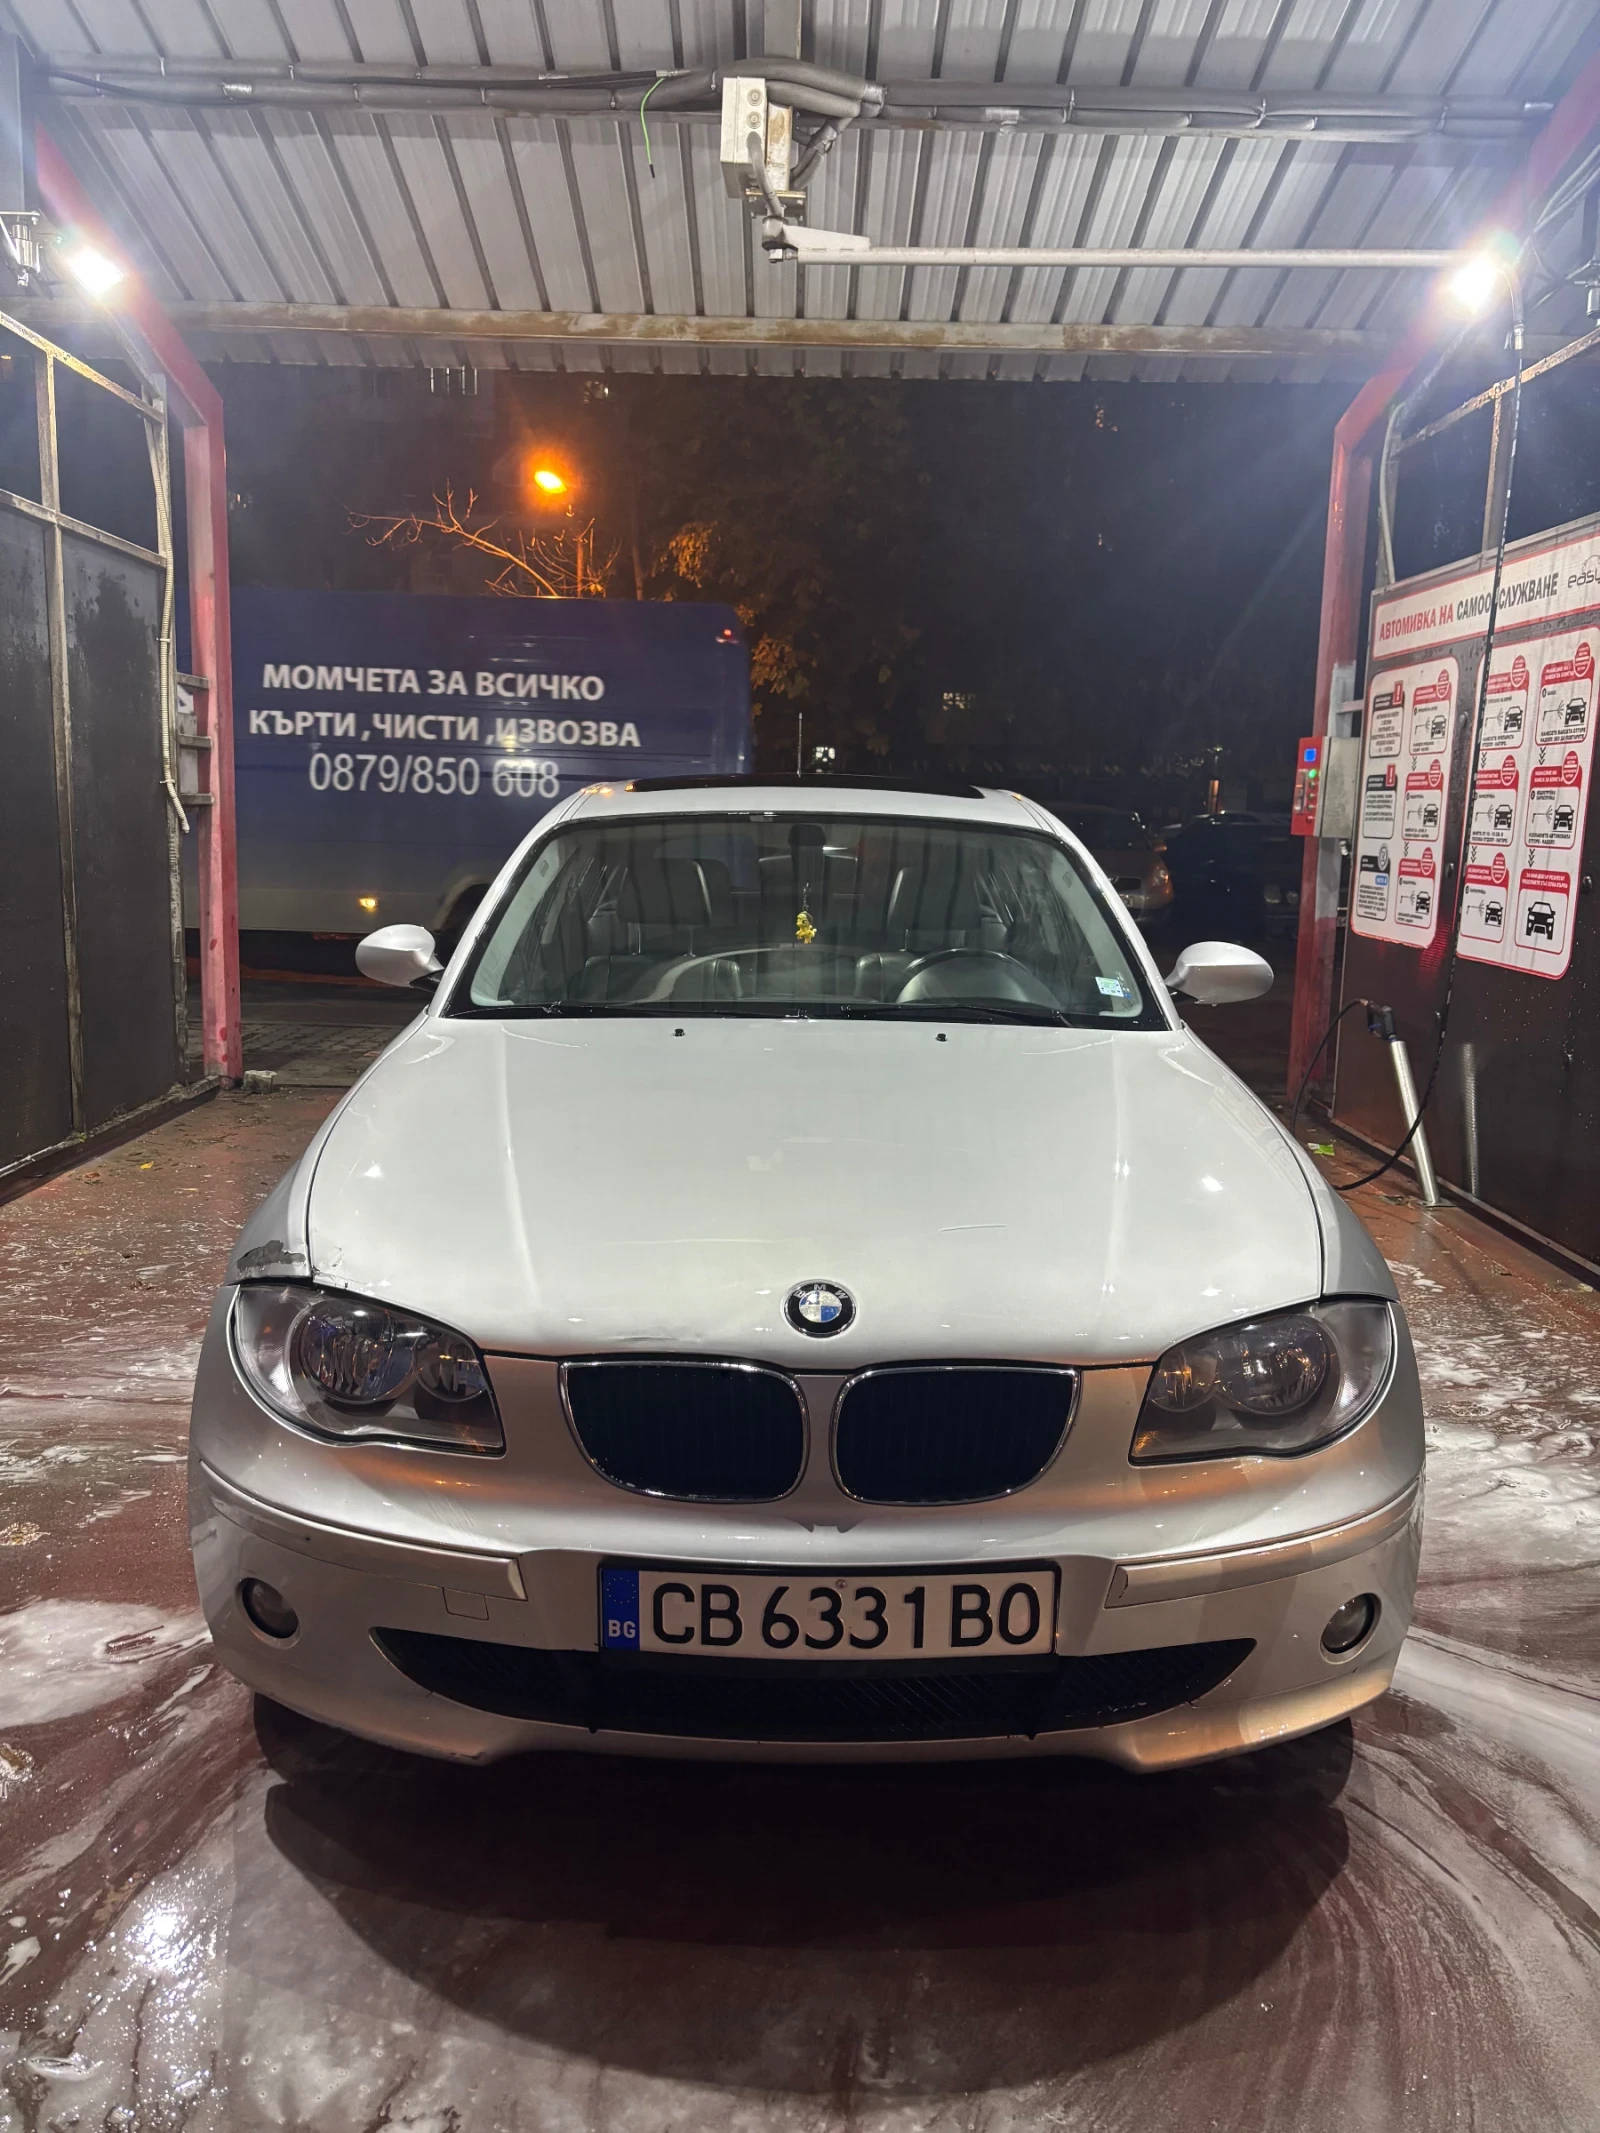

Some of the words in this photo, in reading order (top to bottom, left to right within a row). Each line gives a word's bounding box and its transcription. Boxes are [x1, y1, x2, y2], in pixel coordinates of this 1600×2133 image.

[1379, 611, 1437, 641] АВТОМИВКА
[1439, 605, 1454, 626] НА
[1457, 573, 1559, 620] САМООСЛУЖВАНЕ
[262, 663, 421, 694] МОМЧЕТА
[427, 669, 468, 696] ЗА
[475, 671, 605, 701] ВСИЧКО
[249, 709, 356, 737] КЪРТИ
[309, 752, 481, 796] 0879/850
[492, 758, 560, 798] 608
[793, 1283, 849, 1300] BMW
[608, 1619, 637, 1639] BG
[653, 1582, 743, 1647] CB
[762, 1586, 926, 1650] 6331
